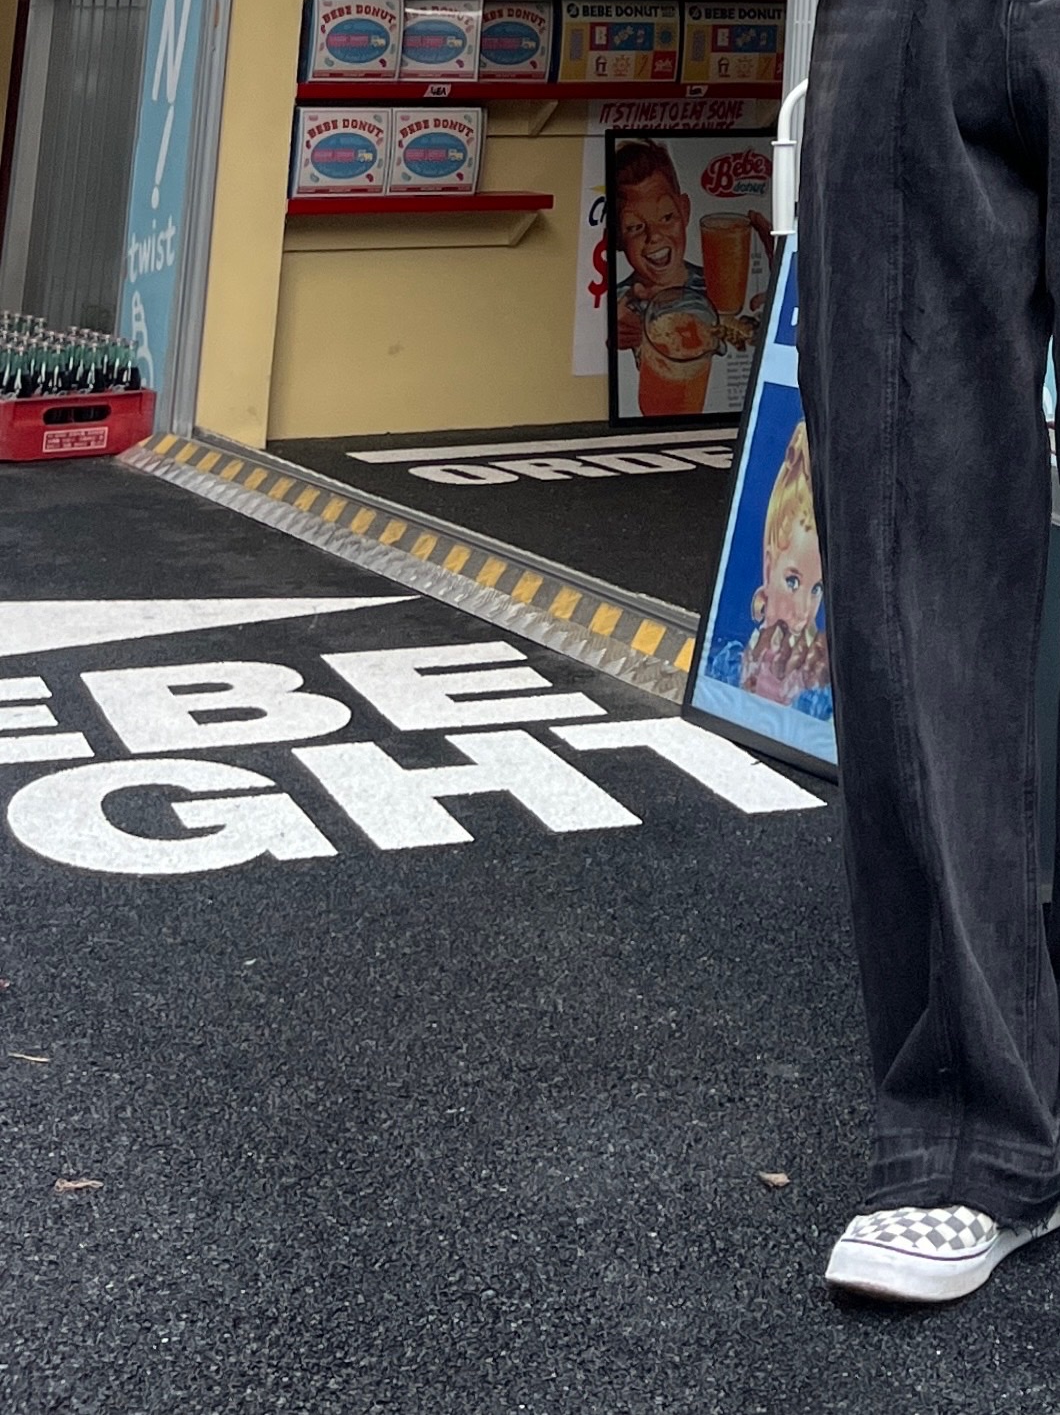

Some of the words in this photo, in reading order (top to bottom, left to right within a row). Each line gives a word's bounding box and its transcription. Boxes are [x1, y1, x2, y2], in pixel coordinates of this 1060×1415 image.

[322, 5, 352, 24] BEBE
[356, 4, 397, 24] DONUT
[507, 8, 546, 27] DONUT
[582, 5, 612, 17] BEBE
[615, 5, 659, 17] DONUT
[704, 8, 736, 19] BEBE
[738, 8, 782, 20] DONUT
[680, 100, 707, 121] EAT
[706, 100, 744, 120] SOME
[307, 119, 338, 139] BEBE
[342, 118, 384, 139] DONUT
[400, 119, 429, 139] BEBE
[433, 118, 475, 138] DONUT
[707, 150, 766, 193] Bebe
[127, 220, 177, 283] twist
